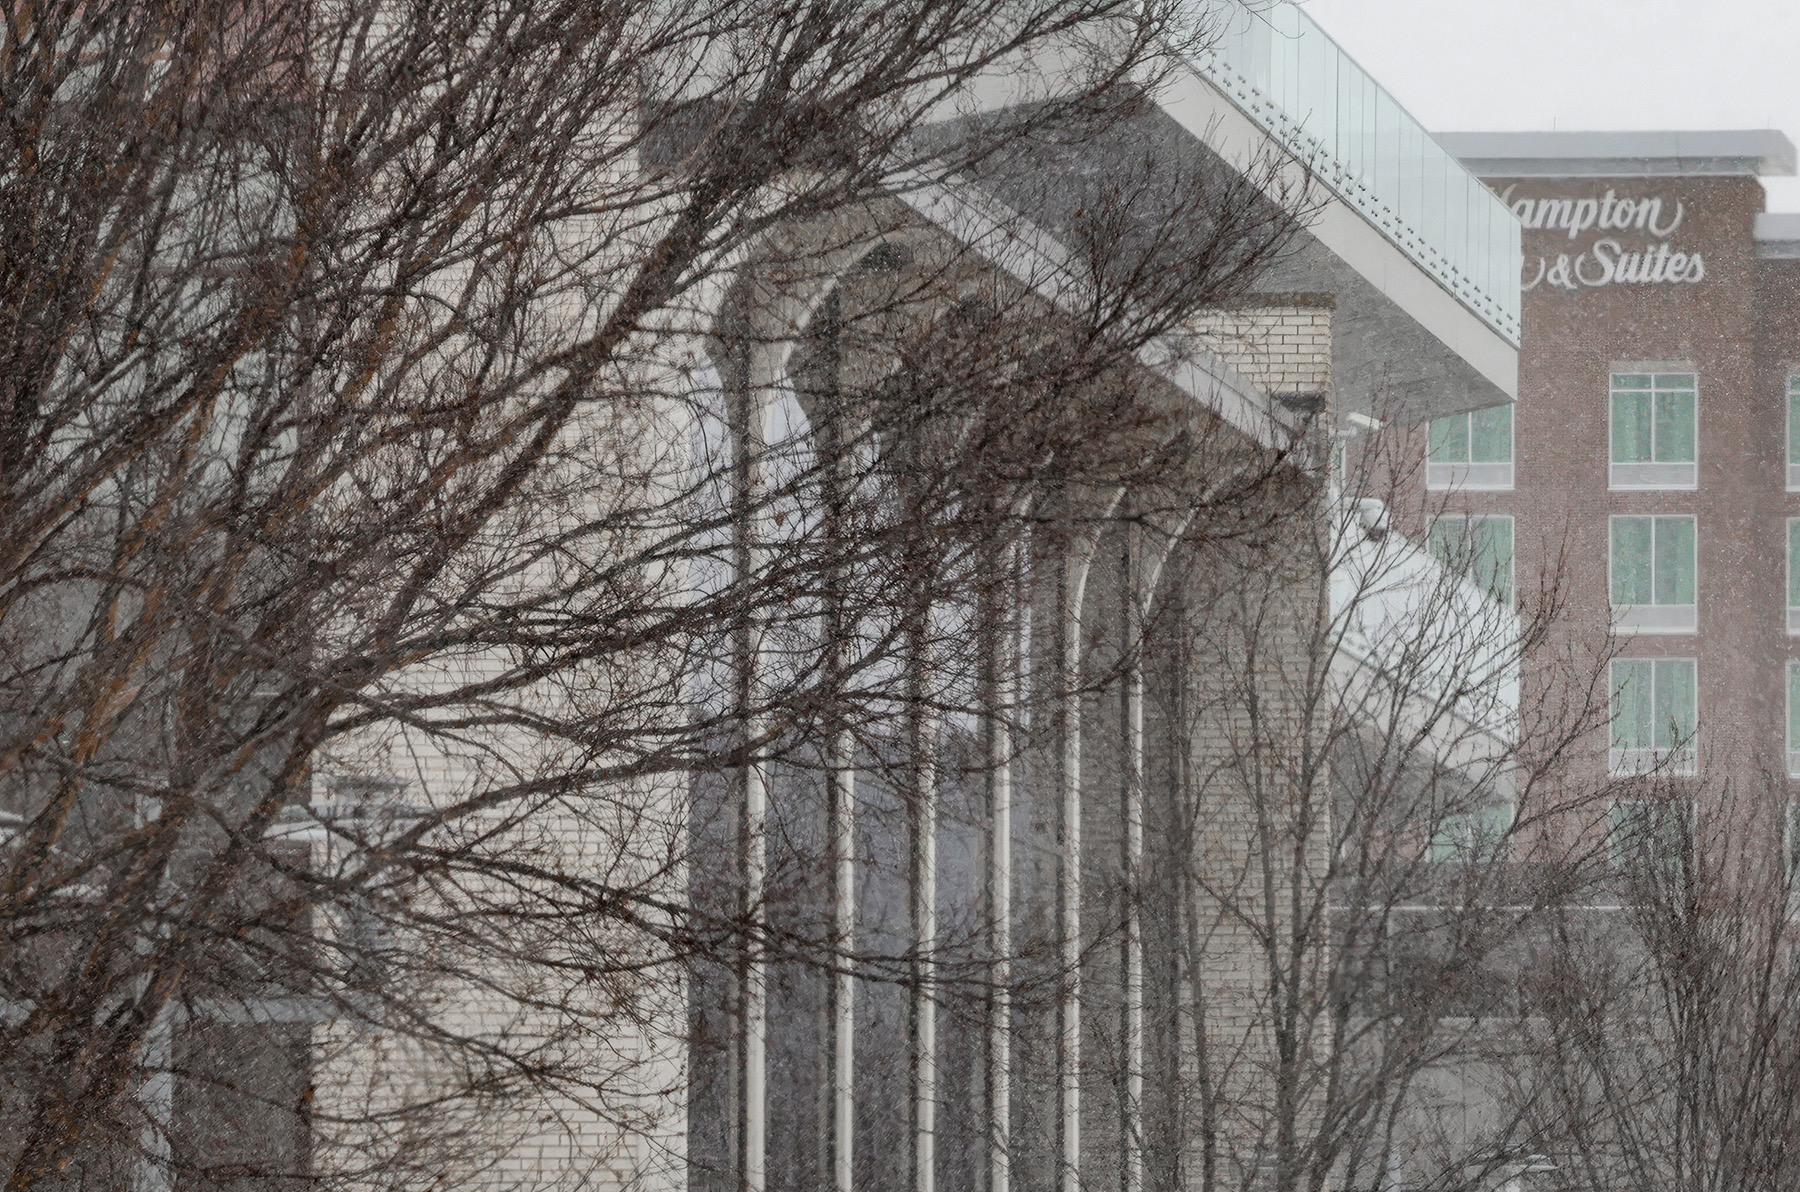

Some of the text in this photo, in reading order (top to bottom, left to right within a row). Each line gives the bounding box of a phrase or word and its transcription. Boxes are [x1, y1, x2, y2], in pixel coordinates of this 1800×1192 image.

[1500, 182, 1683, 239] ampton
[1547, 253, 1577, 289] &
[1574, 238, 1704, 286] Suites
